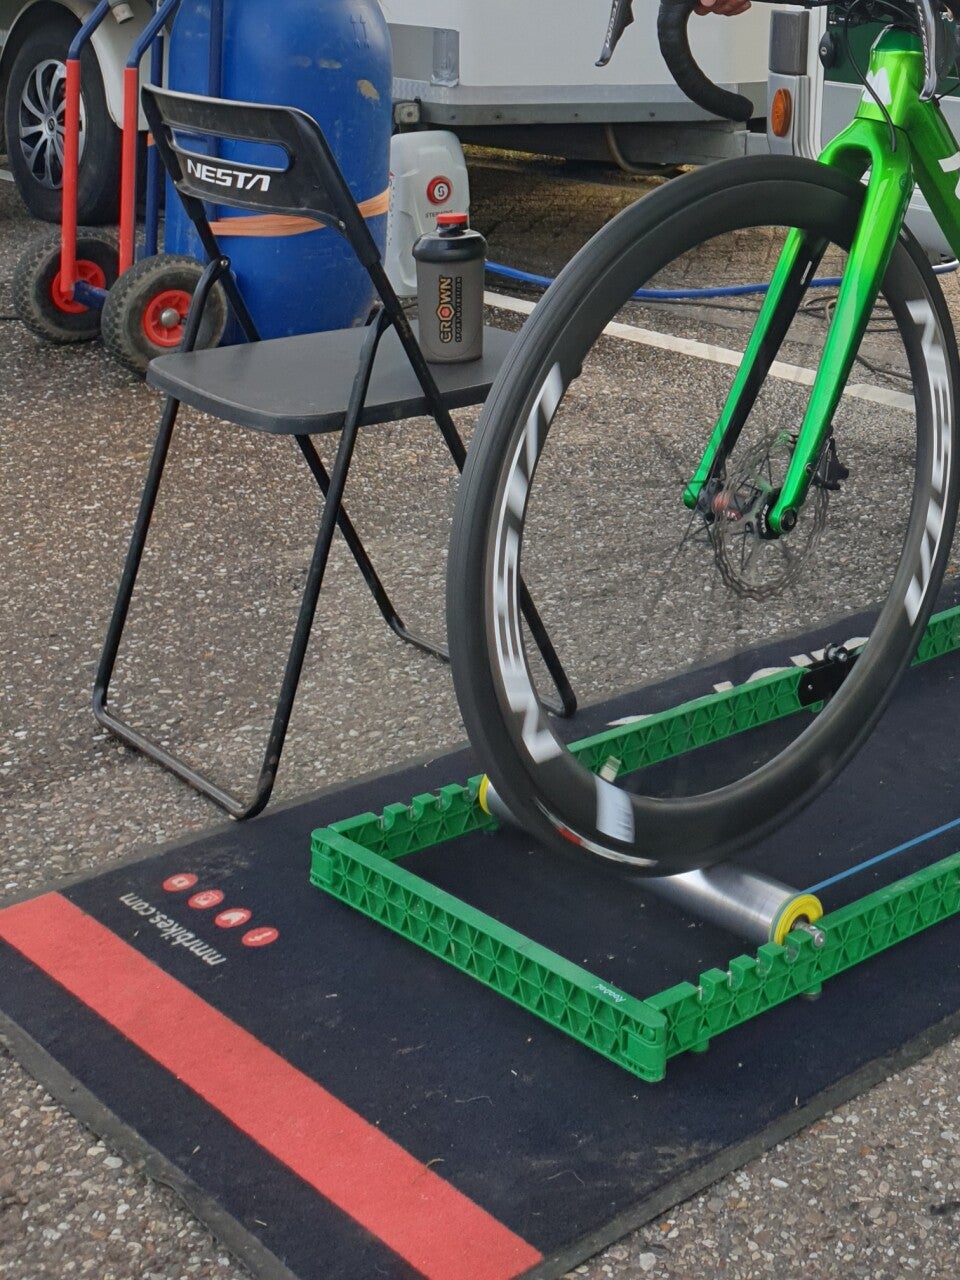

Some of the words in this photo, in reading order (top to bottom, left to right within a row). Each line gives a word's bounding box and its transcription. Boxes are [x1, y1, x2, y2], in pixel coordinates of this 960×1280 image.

[187, 159, 271, 192] NESTA
[435, 276, 455, 343] CROWN
[119, 892, 227, 966] mmrbikes.com
